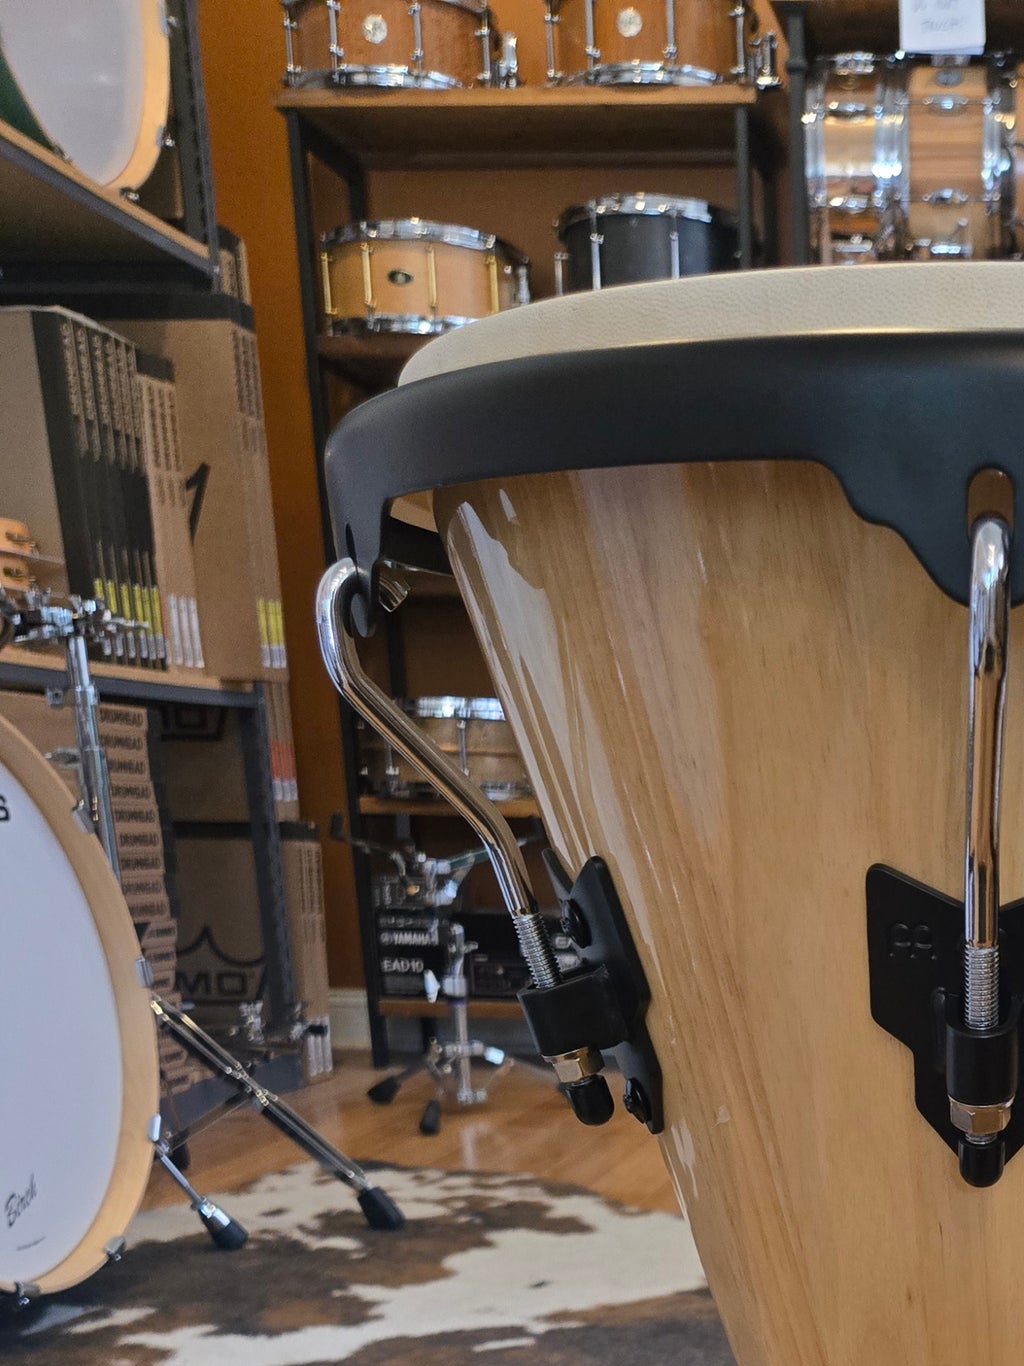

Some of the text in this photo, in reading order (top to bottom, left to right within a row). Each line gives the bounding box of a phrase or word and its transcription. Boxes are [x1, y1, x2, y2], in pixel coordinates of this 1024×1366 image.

[393, 931, 431, 945] YAMAHA
[381, 957, 425, 973] EAD10
[175, 971, 248, 997] MO
